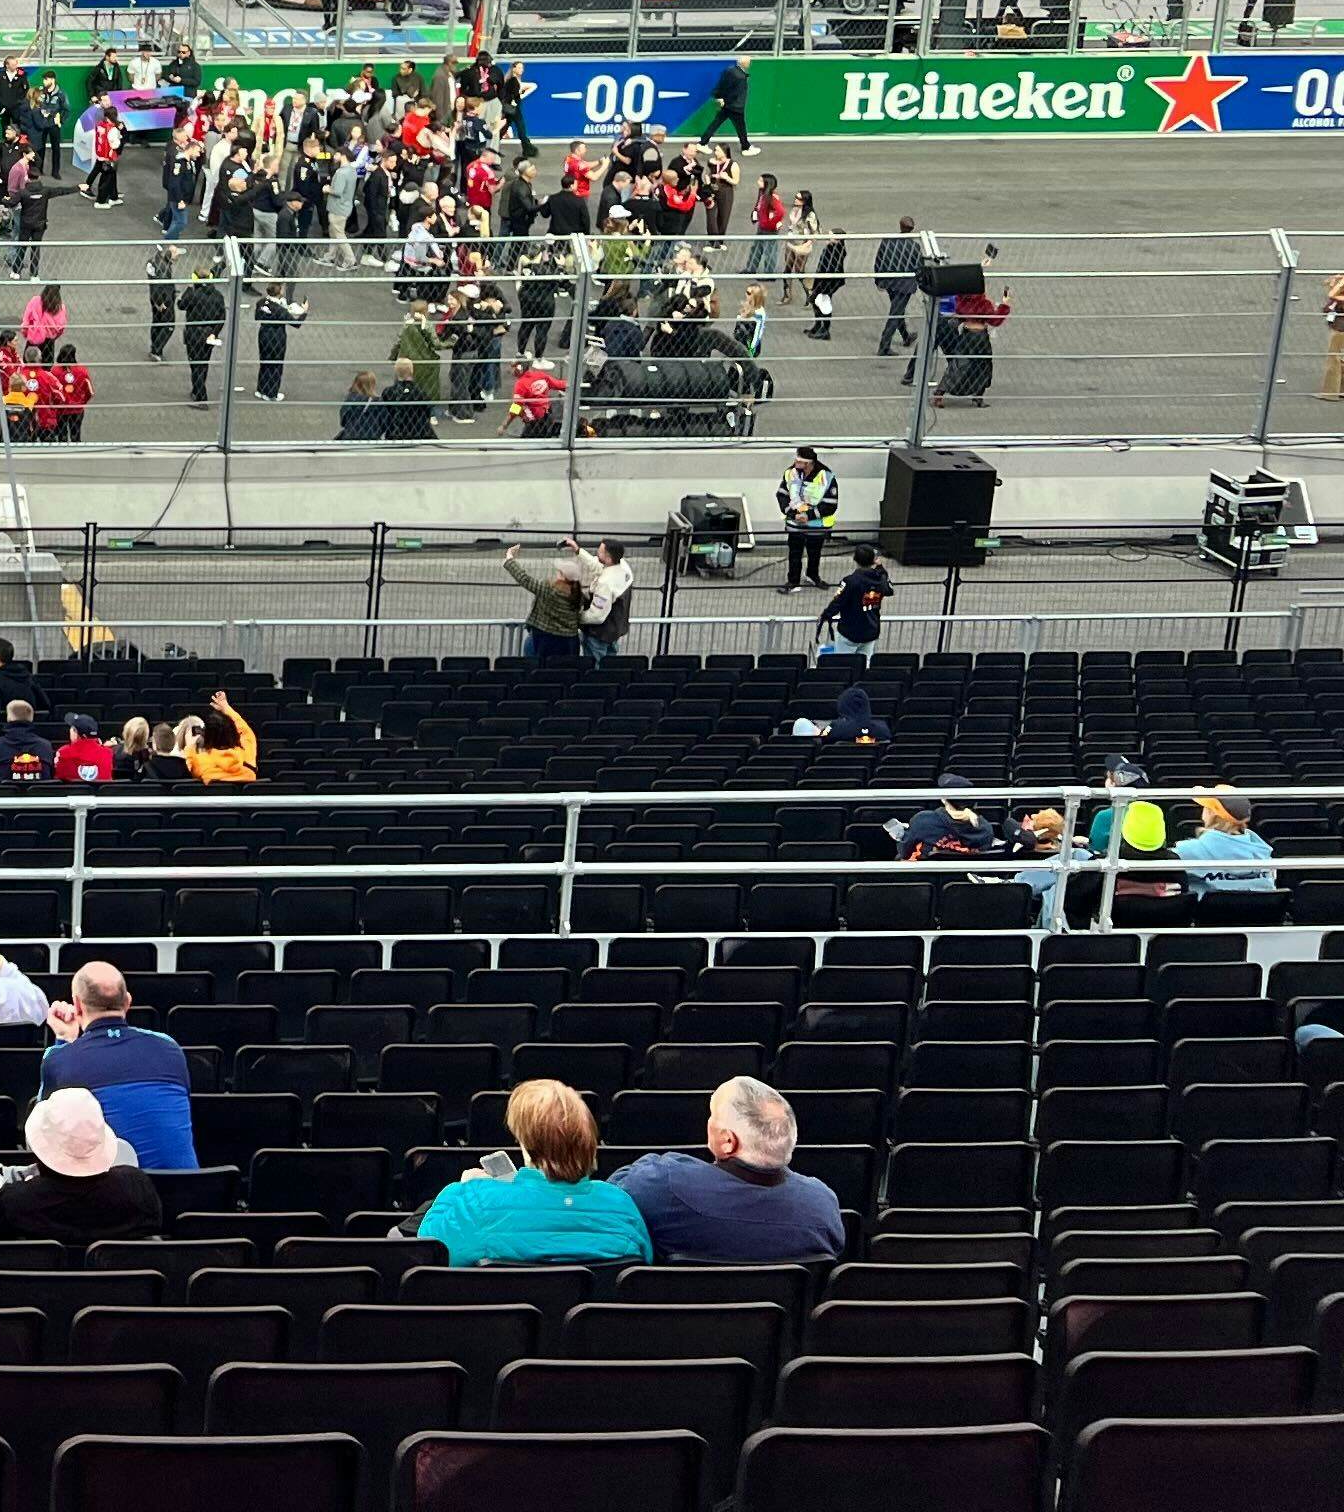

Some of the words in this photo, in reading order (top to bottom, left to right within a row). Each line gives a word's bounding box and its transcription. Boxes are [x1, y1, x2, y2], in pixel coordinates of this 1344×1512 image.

[585, 74, 655, 123] 0.0
[839, 70, 1126, 120] Heineken
[583, 123, 622, 135] ALCOHO
[1282, 117, 1335, 128] ALCOHOL
